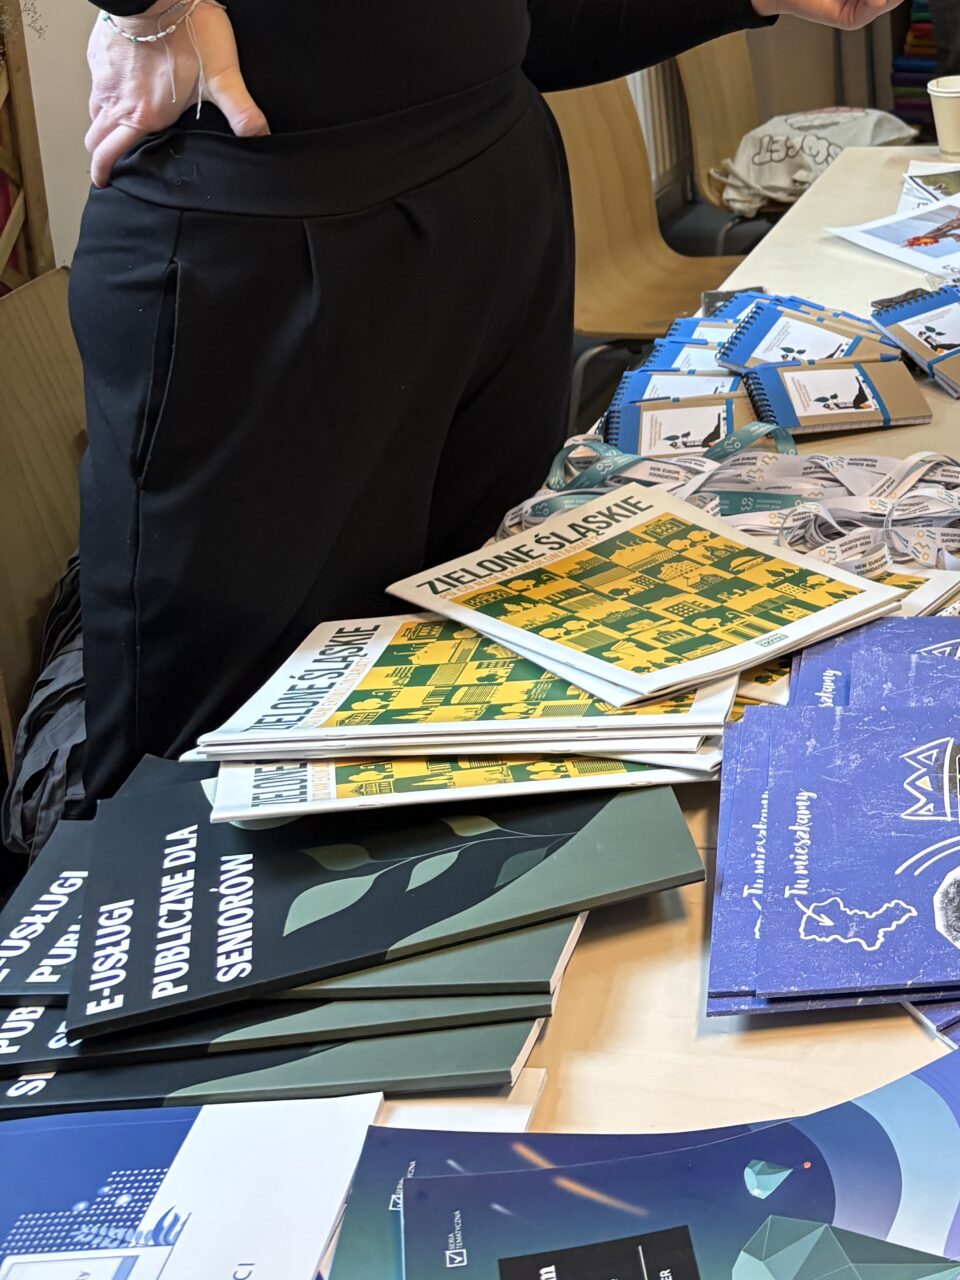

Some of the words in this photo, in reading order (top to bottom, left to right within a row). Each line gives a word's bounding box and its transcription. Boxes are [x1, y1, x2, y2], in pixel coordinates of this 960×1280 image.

[648, 472, 680, 480] FOUNDATION
[662, 468, 680, 476] EUROPE
[416, 544, 546, 596] ZIELONE
[534, 495, 654, 551] ŚLĄSKIE
[839, 534, 870, 548] FOUNDATION
[840, 544, 860, 554] EUROPE
[289, 624, 381, 682] ŚLĄSKIE
[162, 824, 198, 869] DLA
[788, 789, 818, 875] mieszkamy
[152, 869, 196, 1000] PUBLICZNE
[209, 853, 255, 984] SENIORÓW
[86, 899, 135, 1016] E-USŁUGI
